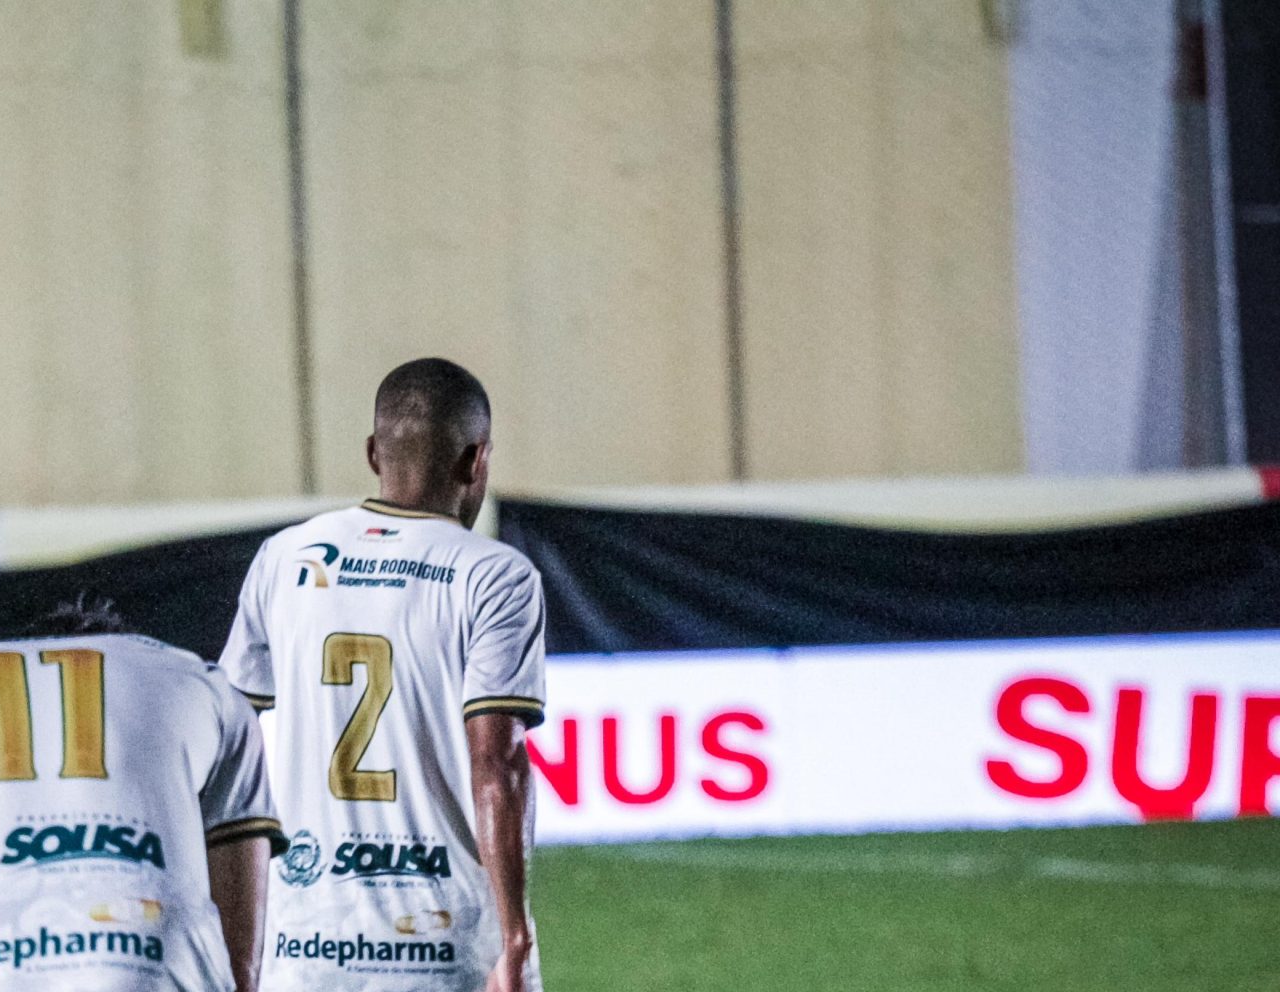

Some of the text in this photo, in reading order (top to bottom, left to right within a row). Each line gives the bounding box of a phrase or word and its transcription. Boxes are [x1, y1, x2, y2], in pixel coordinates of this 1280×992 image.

[340, 557, 456, 584] MAIS RODRIGUES
[321, 632, 396, 802] 2
[0, 823, 167, 870] SOUSA
[330, 842, 452, 878] SOUSA
[275, 931, 455, 967] Redepharma
